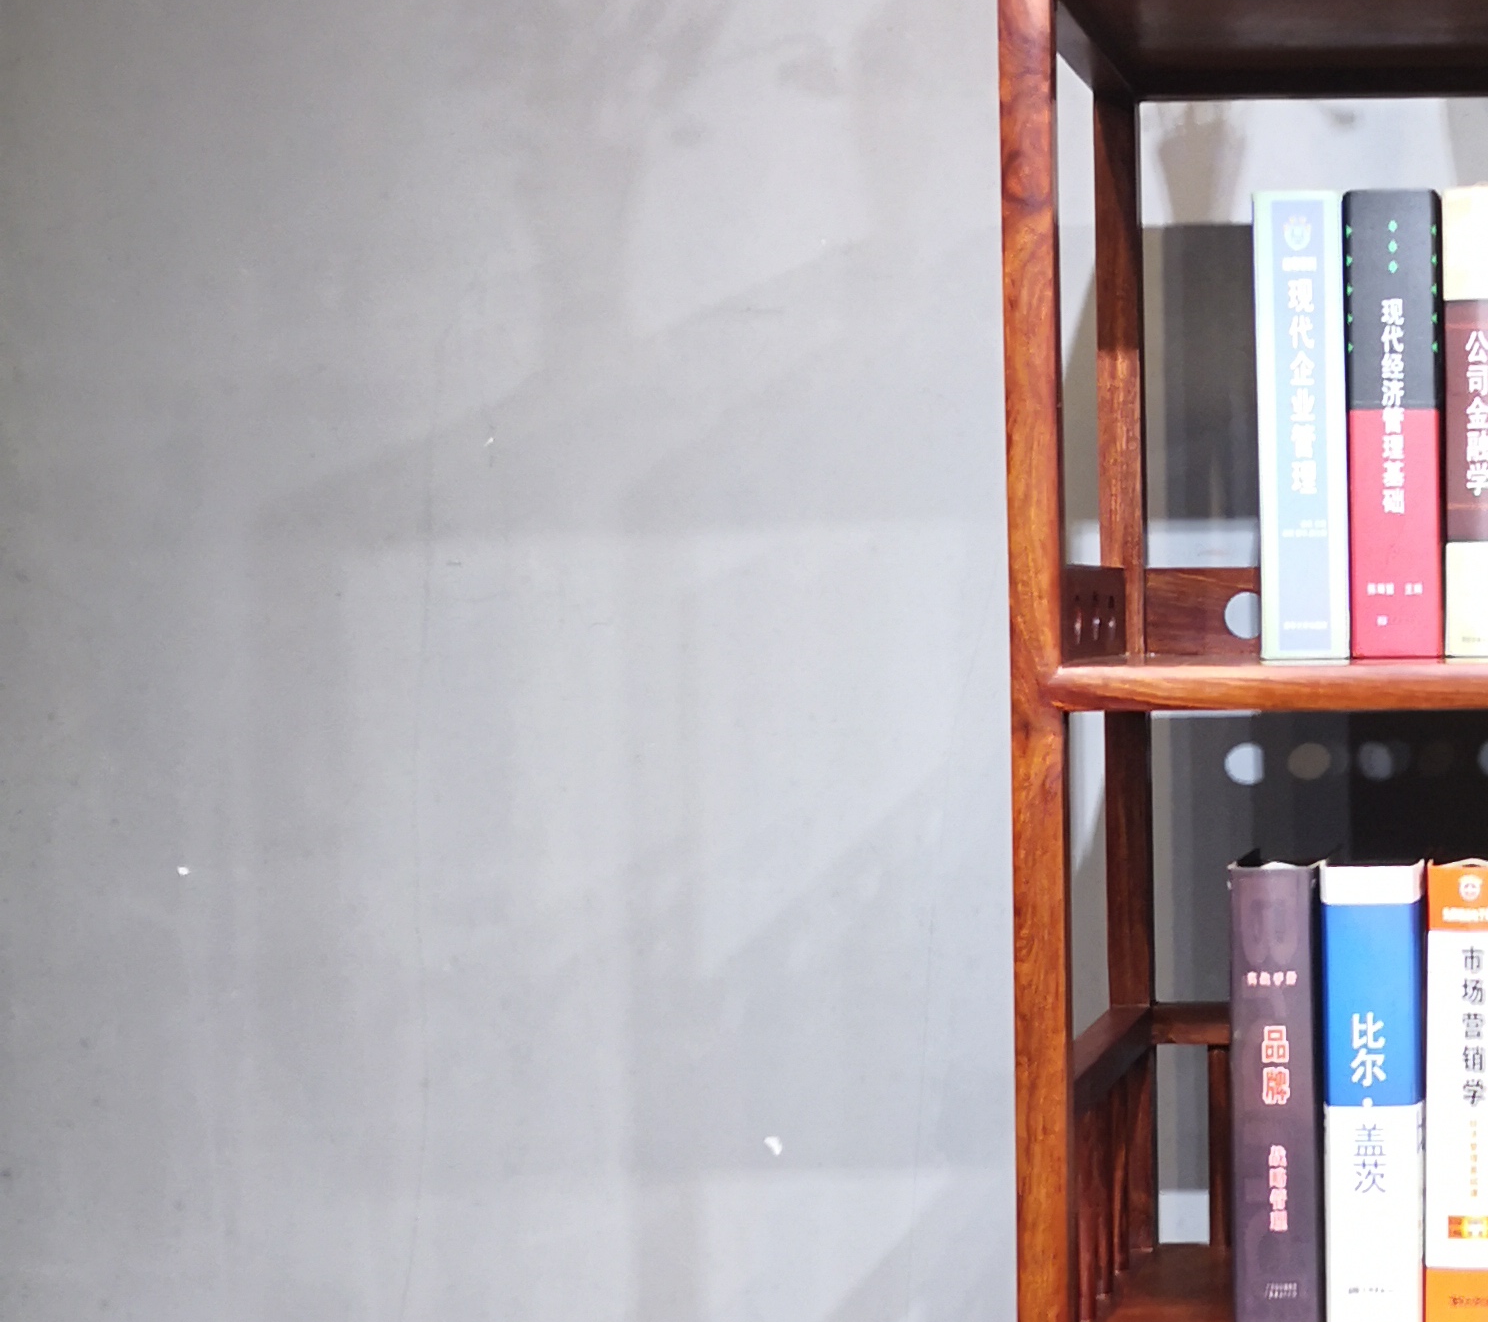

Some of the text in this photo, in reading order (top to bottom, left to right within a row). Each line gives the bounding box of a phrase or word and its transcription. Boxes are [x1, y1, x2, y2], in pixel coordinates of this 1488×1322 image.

[1287, 278, 1318, 495] 现代企业管理
[1380, 298, 1405, 515] 现代经济管理基础
[1261, 1024, 1291, 1106] 品牌
[1461, 946, 1487, 1108] 市场营销学
[1268, 1144, 1289, 1233] 战略管理
